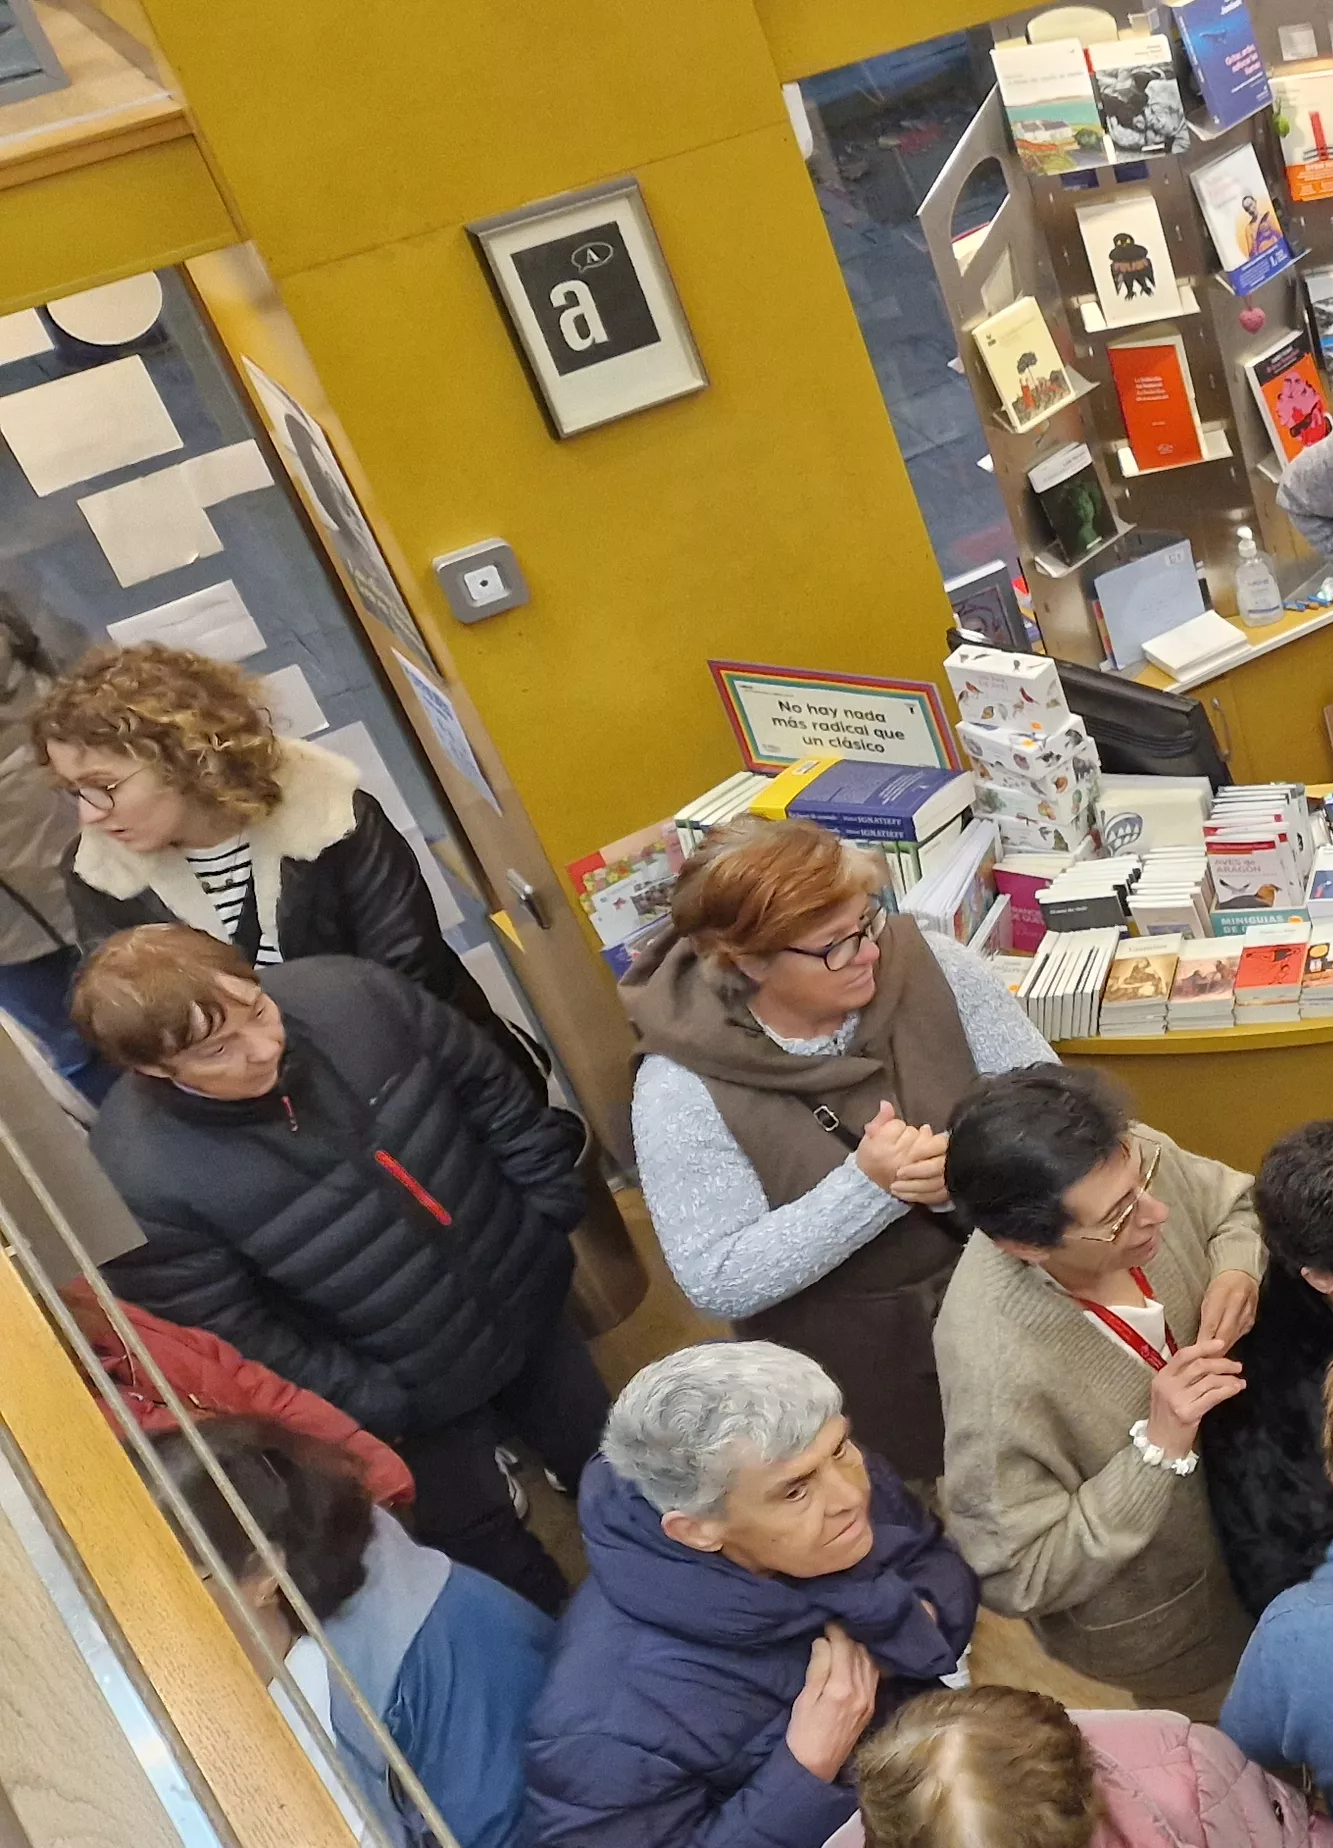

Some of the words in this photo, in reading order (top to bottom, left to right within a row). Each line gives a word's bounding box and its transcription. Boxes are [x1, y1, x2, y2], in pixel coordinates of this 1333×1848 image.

[550, 279, 609, 351] a
[778, 700, 803, 714] No
[807, 703, 838, 719] hay
[844, 707, 886, 723] nada
[771, 716, 807, 730] más
[813, 719, 869, 737] radical
[873, 727, 905, 741] que
[802, 735, 823, 747] un
[828, 735, 885, 754] clásico
